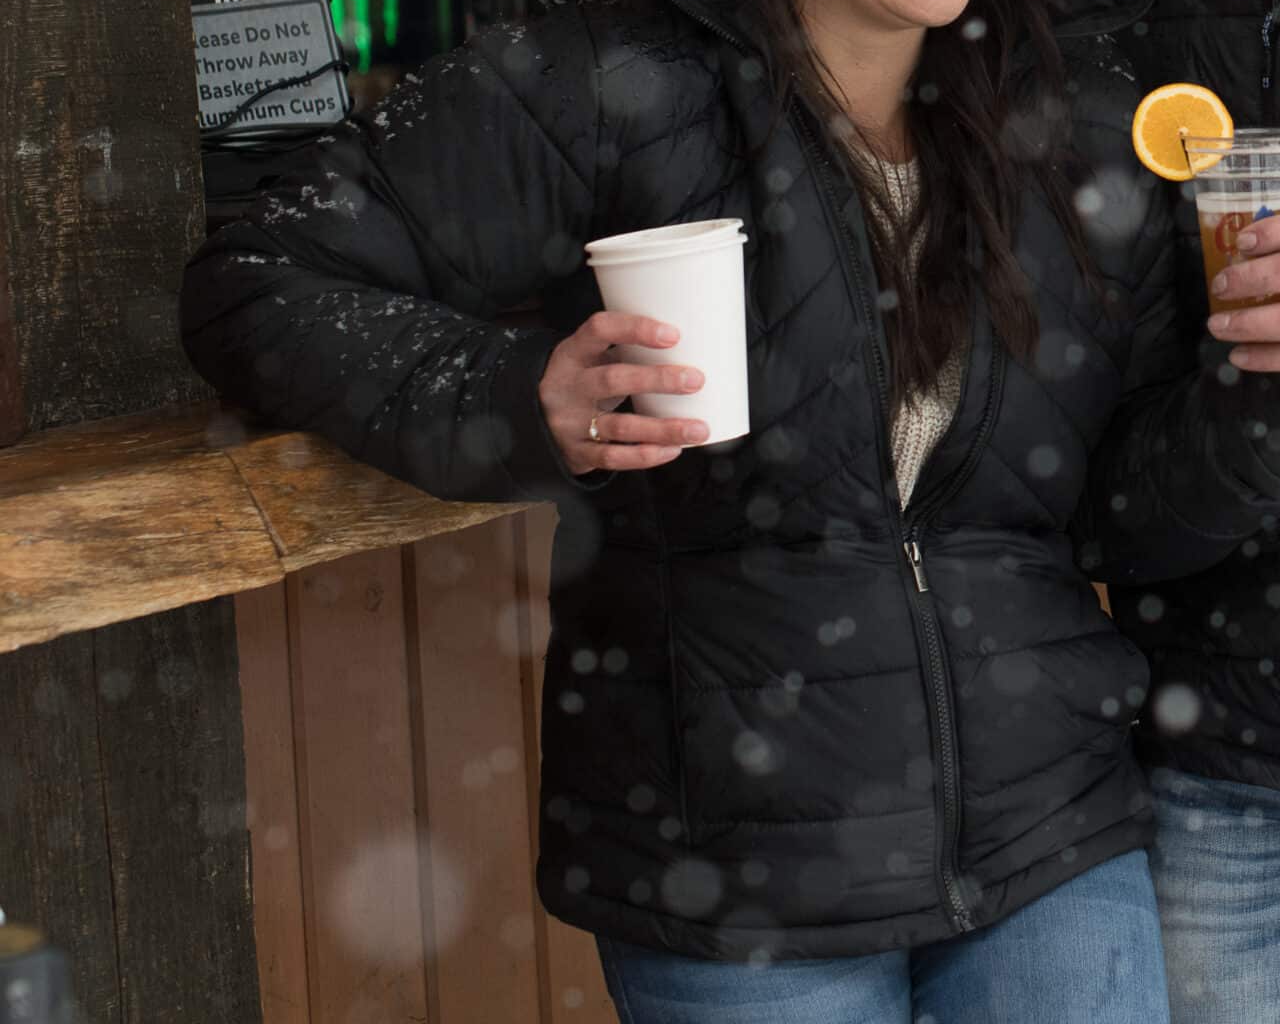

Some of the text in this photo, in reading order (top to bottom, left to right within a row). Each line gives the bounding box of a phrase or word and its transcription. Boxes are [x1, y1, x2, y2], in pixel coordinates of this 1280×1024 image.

[245, 26, 271, 43] Do
[275, 21, 311, 40] Not
[258, 48, 309, 68] Away
[290, 96, 335, 116] Cups
